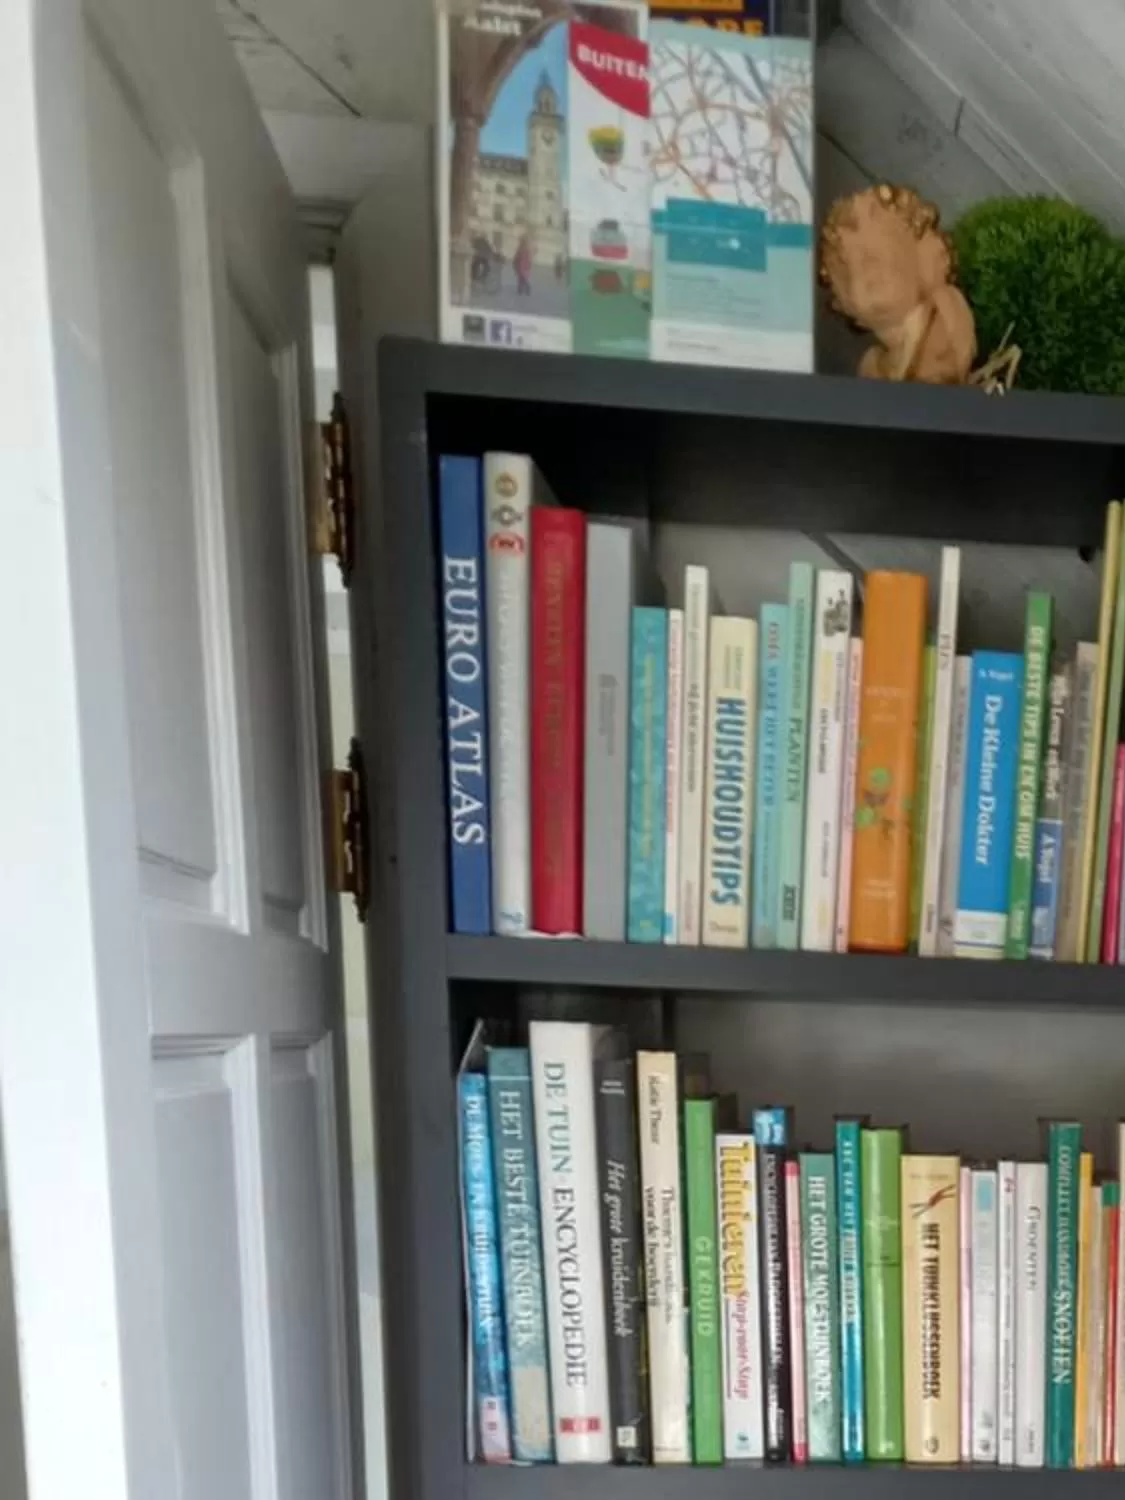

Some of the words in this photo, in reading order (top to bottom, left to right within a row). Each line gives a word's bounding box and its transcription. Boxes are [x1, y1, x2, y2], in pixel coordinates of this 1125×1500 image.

[443, 555, 480, 684] EURO
[1025, 651, 1044, 699] BESTE
[984, 695, 1003, 725] De
[447, 697, 485, 845] ATLAS
[978, 727, 1001, 788] Kleine
[711, 697, 748, 907] HUISHOUDTIPS
[975, 795, 999, 864] Dokter
[542, 1061, 566, 1099] DE
[498, 1090, 523, 1140] HET
[547, 1108, 573, 1174] TUIN
[503, 1148, 532, 1216] BESTE
[607, 1159, 627, 1190] Het
[808, 1176, 828, 1207] HET
[719, 1141, 753, 1298] Tuinieren
[809, 1214, 830, 1271] GROTE
[551, 1187, 588, 1388] ENCYCLOPEDIE
[695, 1236, 714, 1338] GEKRUID
[1051, 1288, 1073, 1385] SNOEIEN
